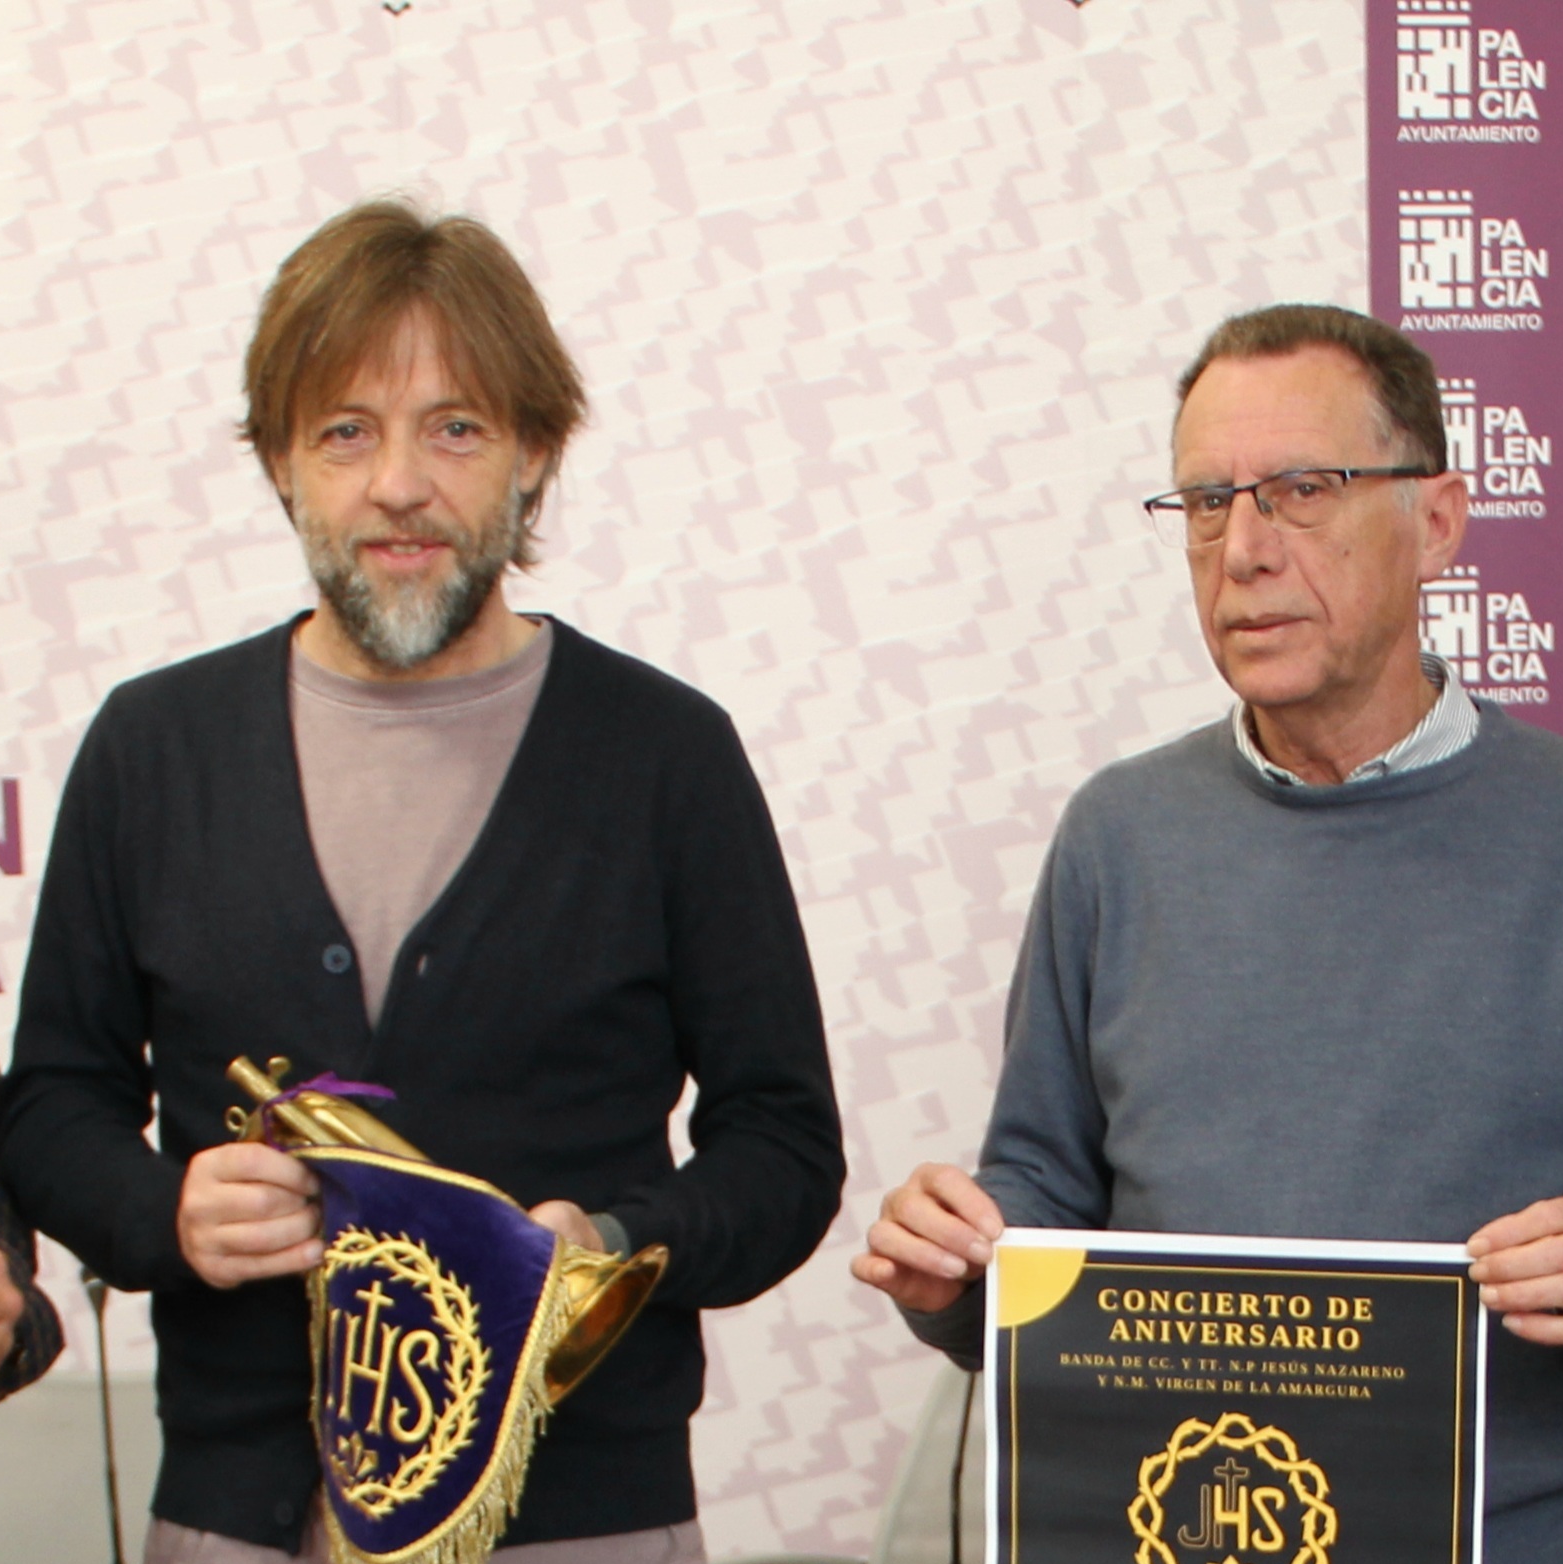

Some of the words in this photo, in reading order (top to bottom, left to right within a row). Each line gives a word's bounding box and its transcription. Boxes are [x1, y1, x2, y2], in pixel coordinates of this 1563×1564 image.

[1478, 28, 1524, 58] PA
[1478, 60, 1546, 89] LEN
[1478, 90, 1538, 120] CIA
[1397, 125, 1541, 142] AYUNTAMIENTO
[1481, 218, 1526, 247] PA
[1481, 249, 1549, 277] LEN
[1480, 279, 1542, 308] CIA
[1400, 314, 1543, 331] AYUNTAMIENTO
[1484, 406, 1528, 436] PA
[1484, 436, 1551, 465] LEN
[1484, 466, 1544, 495] CIA
[1467, 500, 1547, 519] AMIENTO
[1487, 593, 1532, 621] PA
[1487, 622, 1554, 651] LEN
[1487, 652, 1547, 681] CIA
[1468, 687, 1549, 704] AMIENTO
[1098, 1287, 1312, 1319] CONCIERTO
[1327, 1296, 1374, 1322] DE
[1109, 1318, 1362, 1351] ANIVERSARIO
[1060, 1353, 1115, 1367] BANDA
[1122, 1354, 1142, 1368] DE
[1149, 1356, 1174, 1369] CC.
[1181, 1358, 1192, 1370] Y
[1198, 1359, 1222, 1371] TT.
[1230, 1360, 1255, 1373] N.P
[1260, 1360, 1308, 1375] JESÚS
[1314, 1364, 1406, 1379] NAZARENO
[1097, 1375, 1108, 1387] Y
[1113, 1375, 1148, 1388] N.M.
[1155, 1377, 1216, 1391] VIRGEN
[1223, 1380, 1243, 1392] DE
[1249, 1381, 1271, 1394] LA
[1277, 1382, 1371, 1398] AMARGURA
